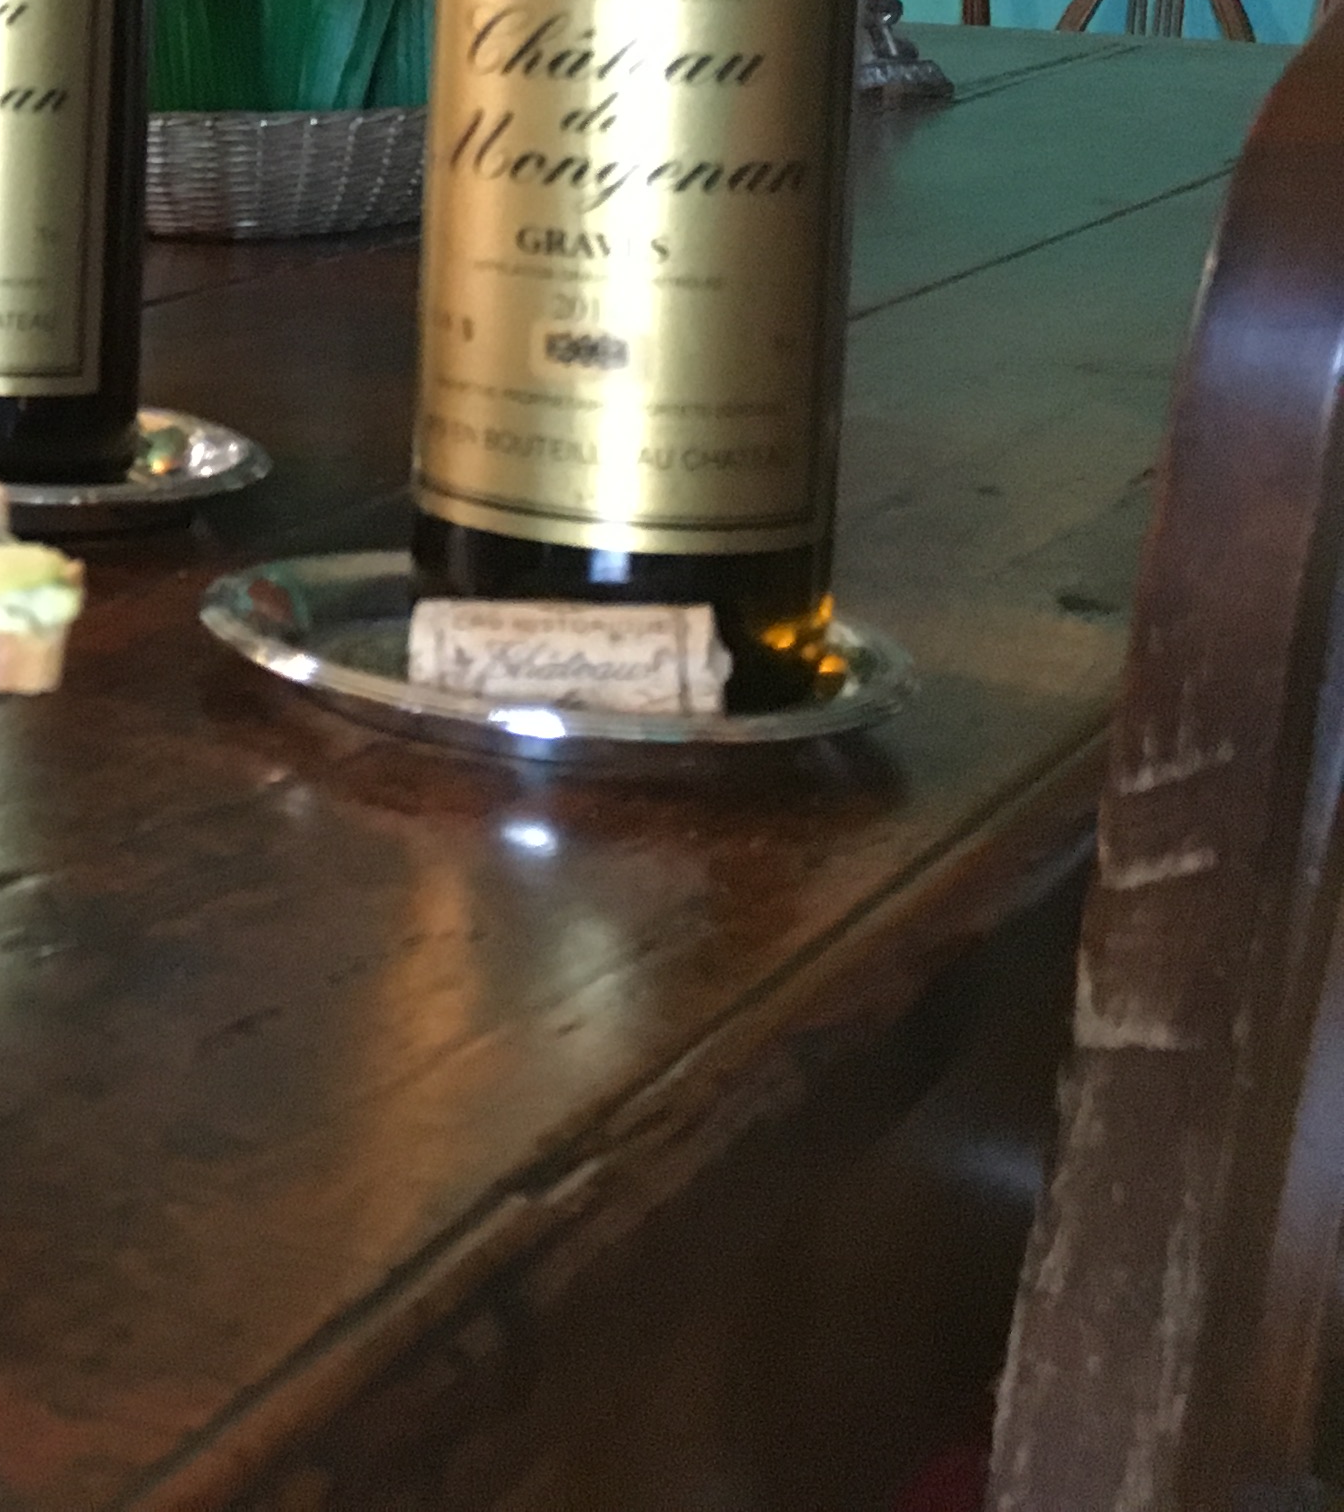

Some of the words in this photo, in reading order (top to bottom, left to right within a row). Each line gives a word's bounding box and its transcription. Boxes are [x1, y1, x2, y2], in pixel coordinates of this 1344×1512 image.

[467, 3, 765, 87] Châtau
[514, 226, 670, 264] GRAVS
[483, 427, 615, 468] BOUTEILL
